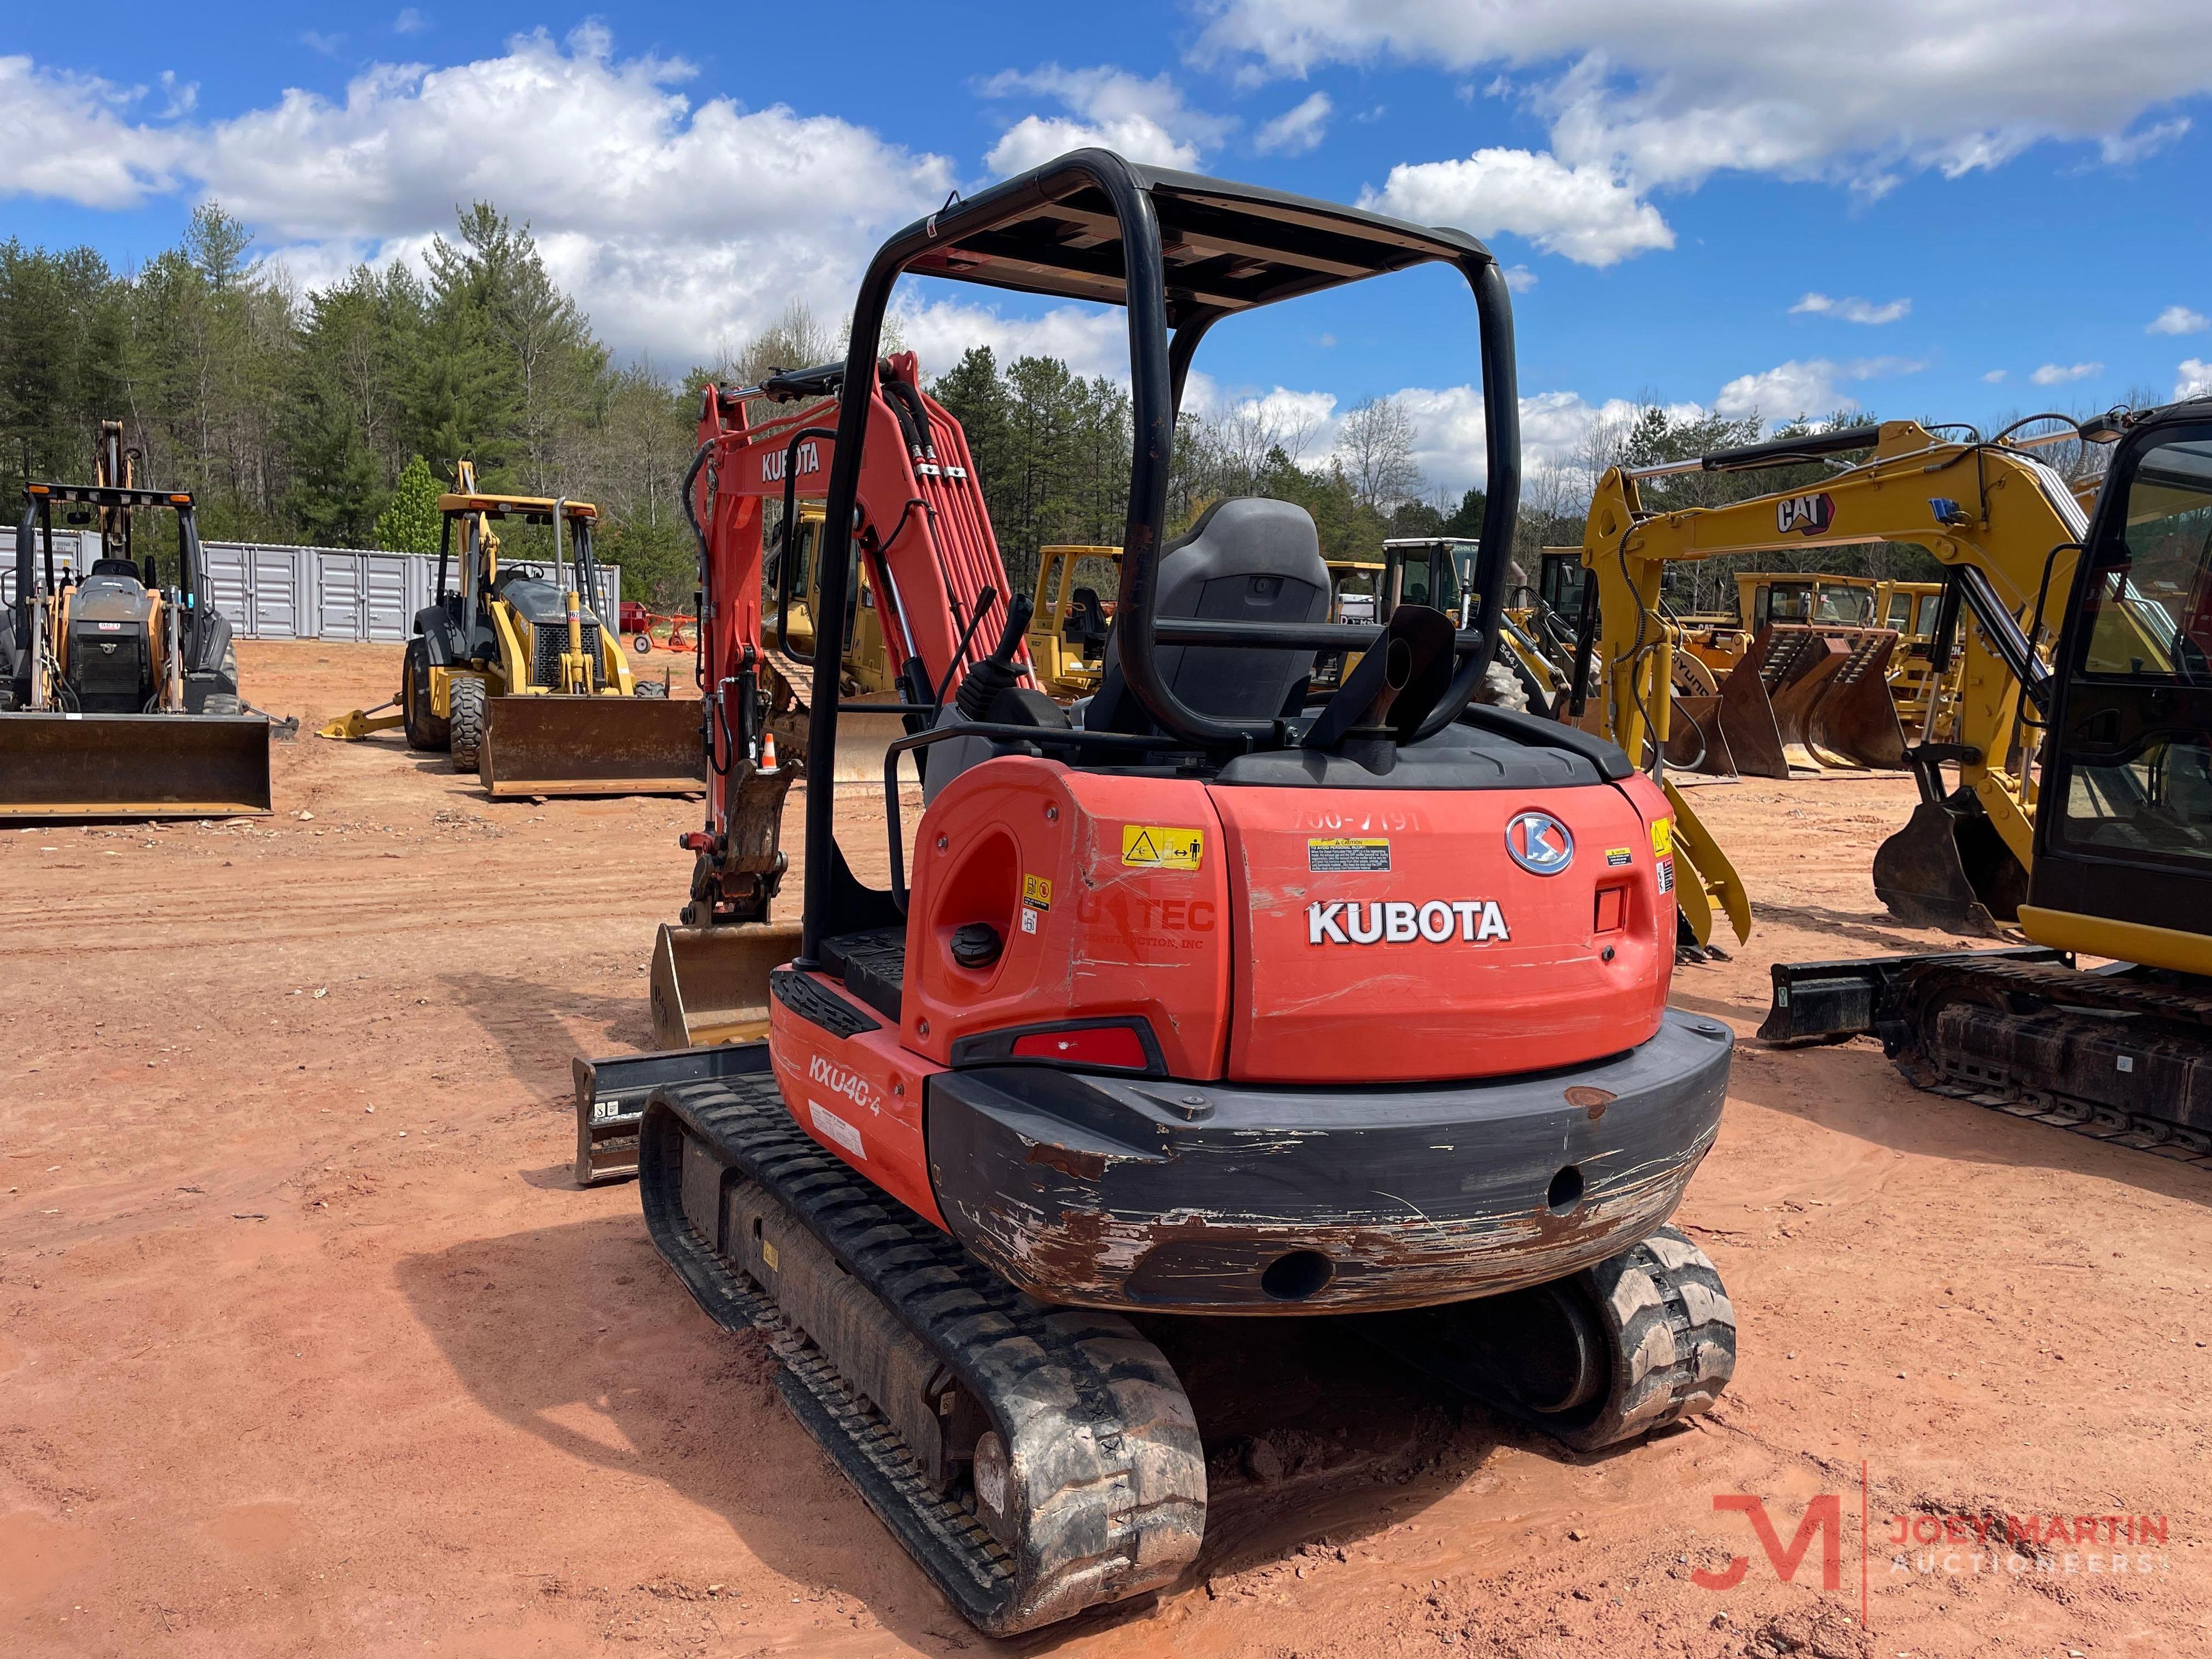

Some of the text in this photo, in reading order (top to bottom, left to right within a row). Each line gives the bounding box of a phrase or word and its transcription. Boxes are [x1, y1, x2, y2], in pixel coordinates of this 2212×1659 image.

[1777, 494, 1820, 532] CAT
[1499, 643, 1518, 669] 544J
[1309, 900, 1509, 944] KUBOTA
[1181, 940, 1203, 949] INC
